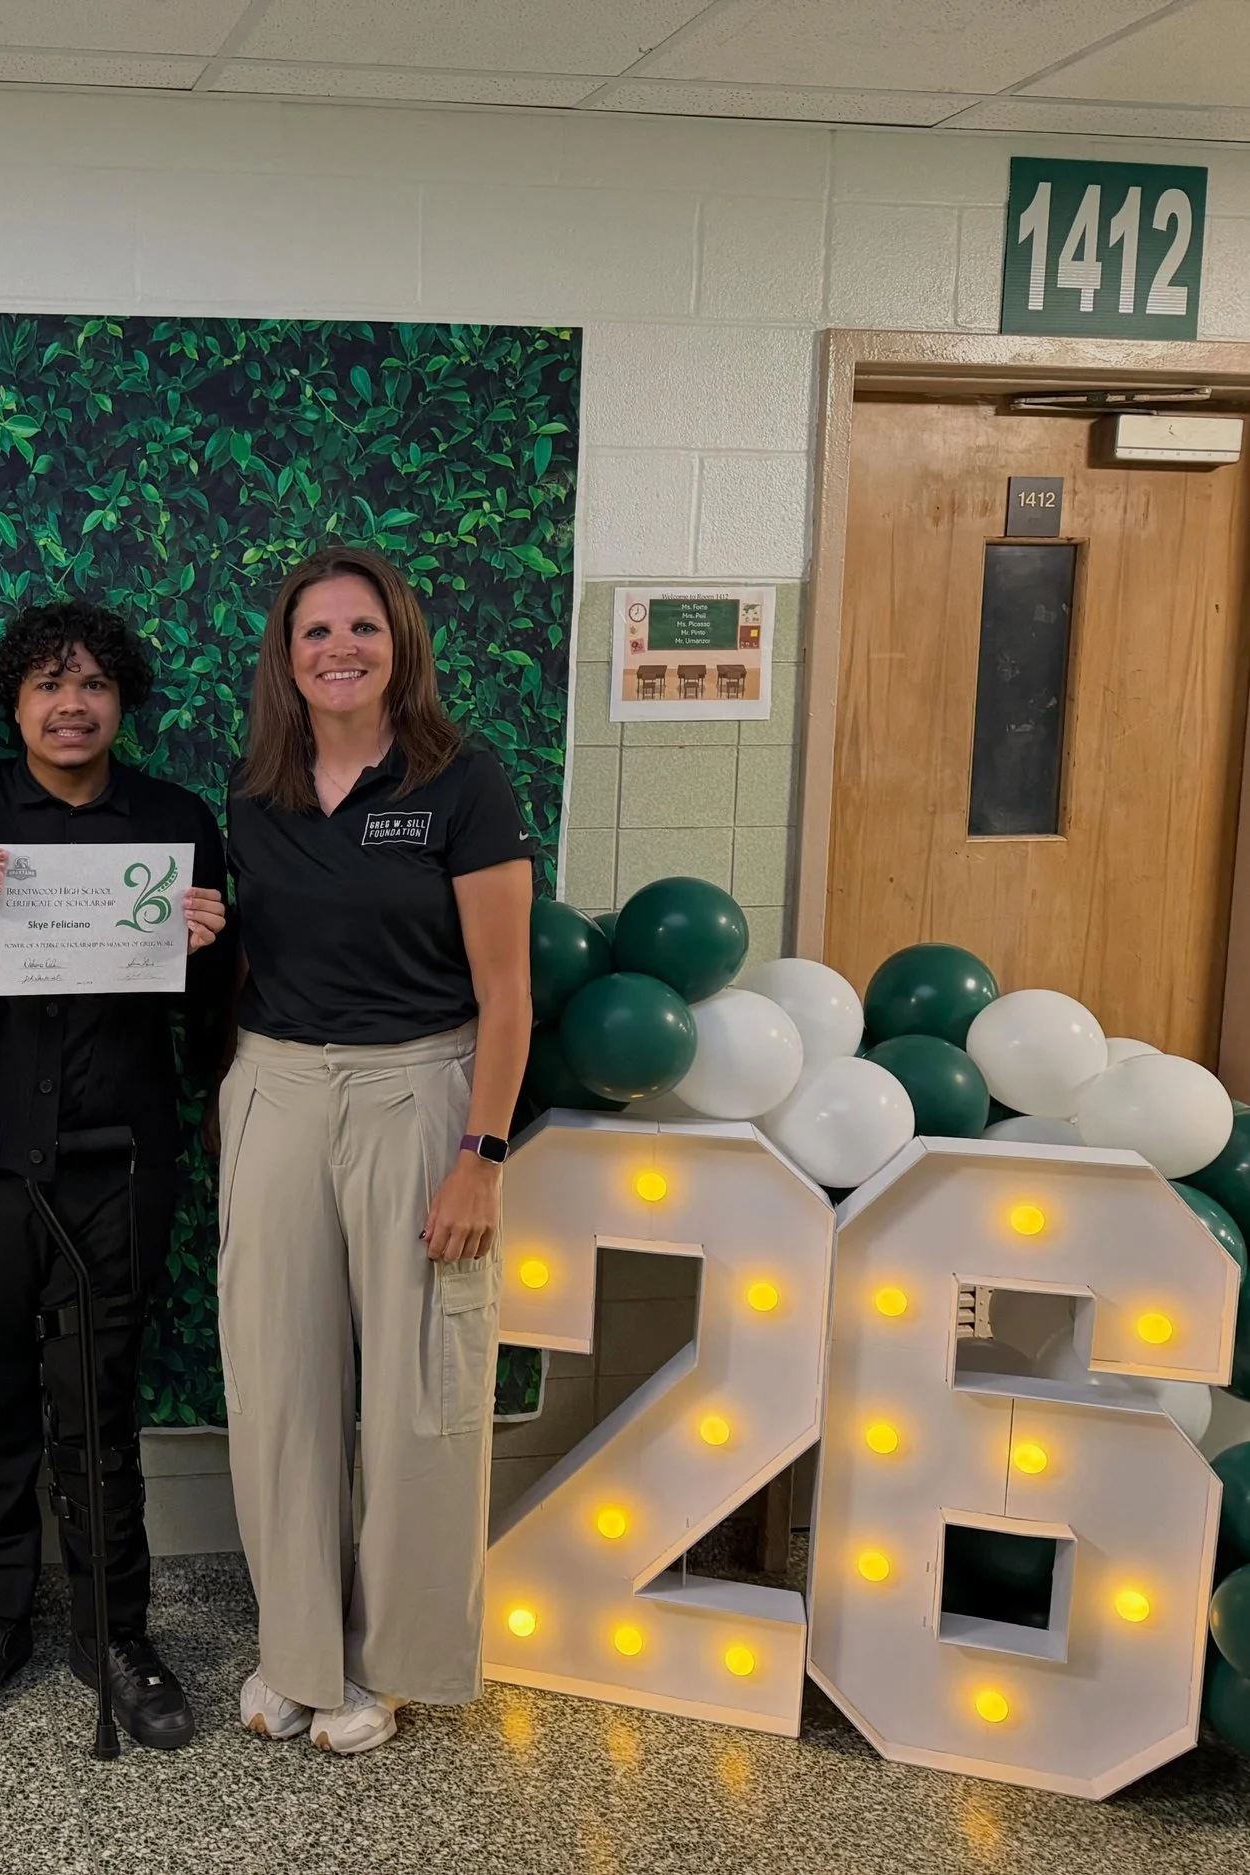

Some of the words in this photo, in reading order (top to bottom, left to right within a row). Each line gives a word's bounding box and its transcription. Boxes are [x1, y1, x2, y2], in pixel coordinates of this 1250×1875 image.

[1018, 182, 1193, 316] 1412
[1018, 491, 1056, 508] 1412
[369, 820, 391, 829] GREG
[393, 820, 403, 828] W.
[406, 819, 426, 829] SILL
[369, 828, 422, 838] FOUNDATION
[28, 920, 48, 930] Skye
[51, 920, 91, 929] Feliciano
